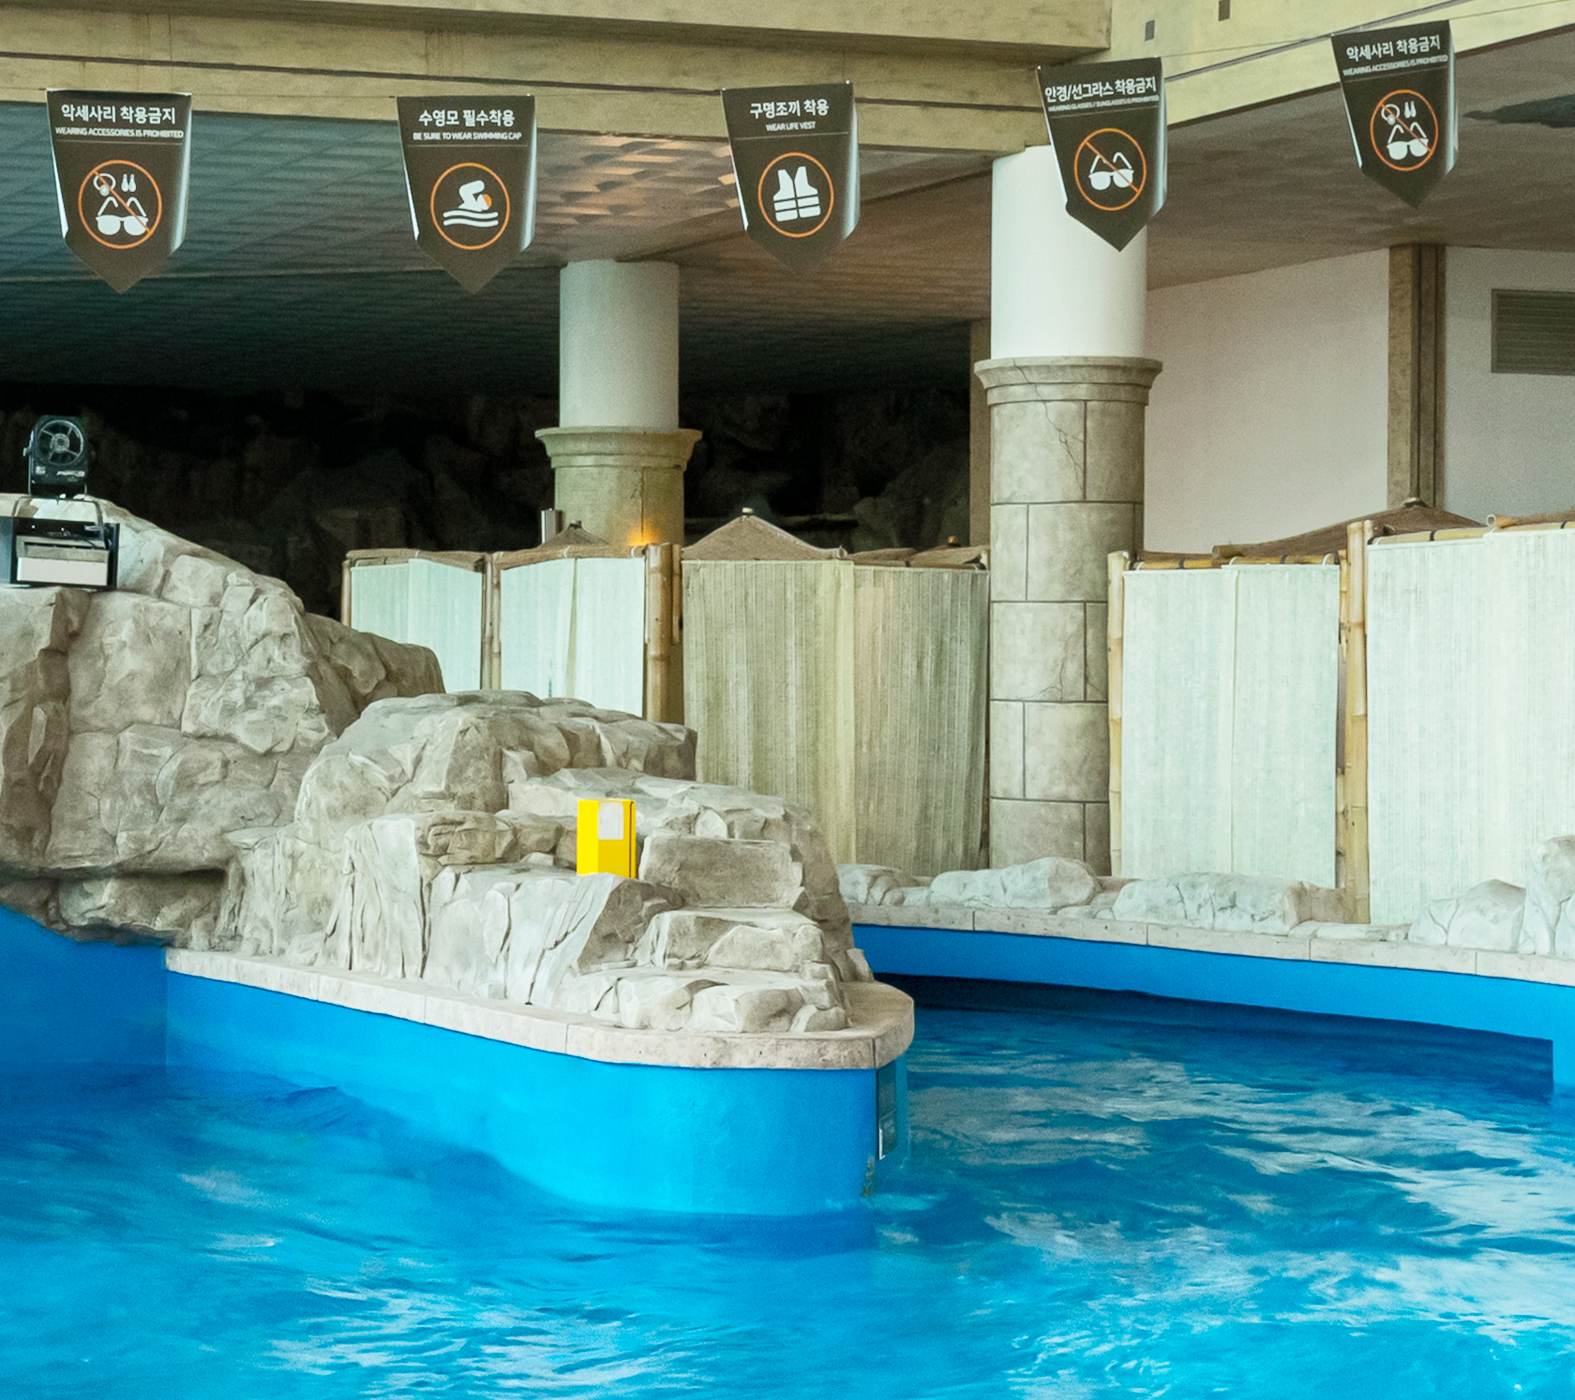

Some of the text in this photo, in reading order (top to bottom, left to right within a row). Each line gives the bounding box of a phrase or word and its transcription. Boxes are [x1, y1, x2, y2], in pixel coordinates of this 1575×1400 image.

[1346, 34, 1441, 62] 악세사리 착용금지
[1045, 76, 1157, 103] 안경/선그라스 착용금지
[61, 104, 176, 124] 악세사리 착용금지
[419, 109, 515, 127] 수영모 필수착용
[750, 99, 829, 119] 구명조끼 착용
[55, 127, 87, 136] WEARING
[88, 128, 135, 137] ACCESSORIES
[766, 121, 816, 131] WEAR LIFE VEST
[413, 132, 422, 140] BE
[423, 132, 441, 140] SURE
[442, 132, 451, 140] TO
[452, 132, 472, 140] WEAR
[508, 132, 522, 140] CAP
